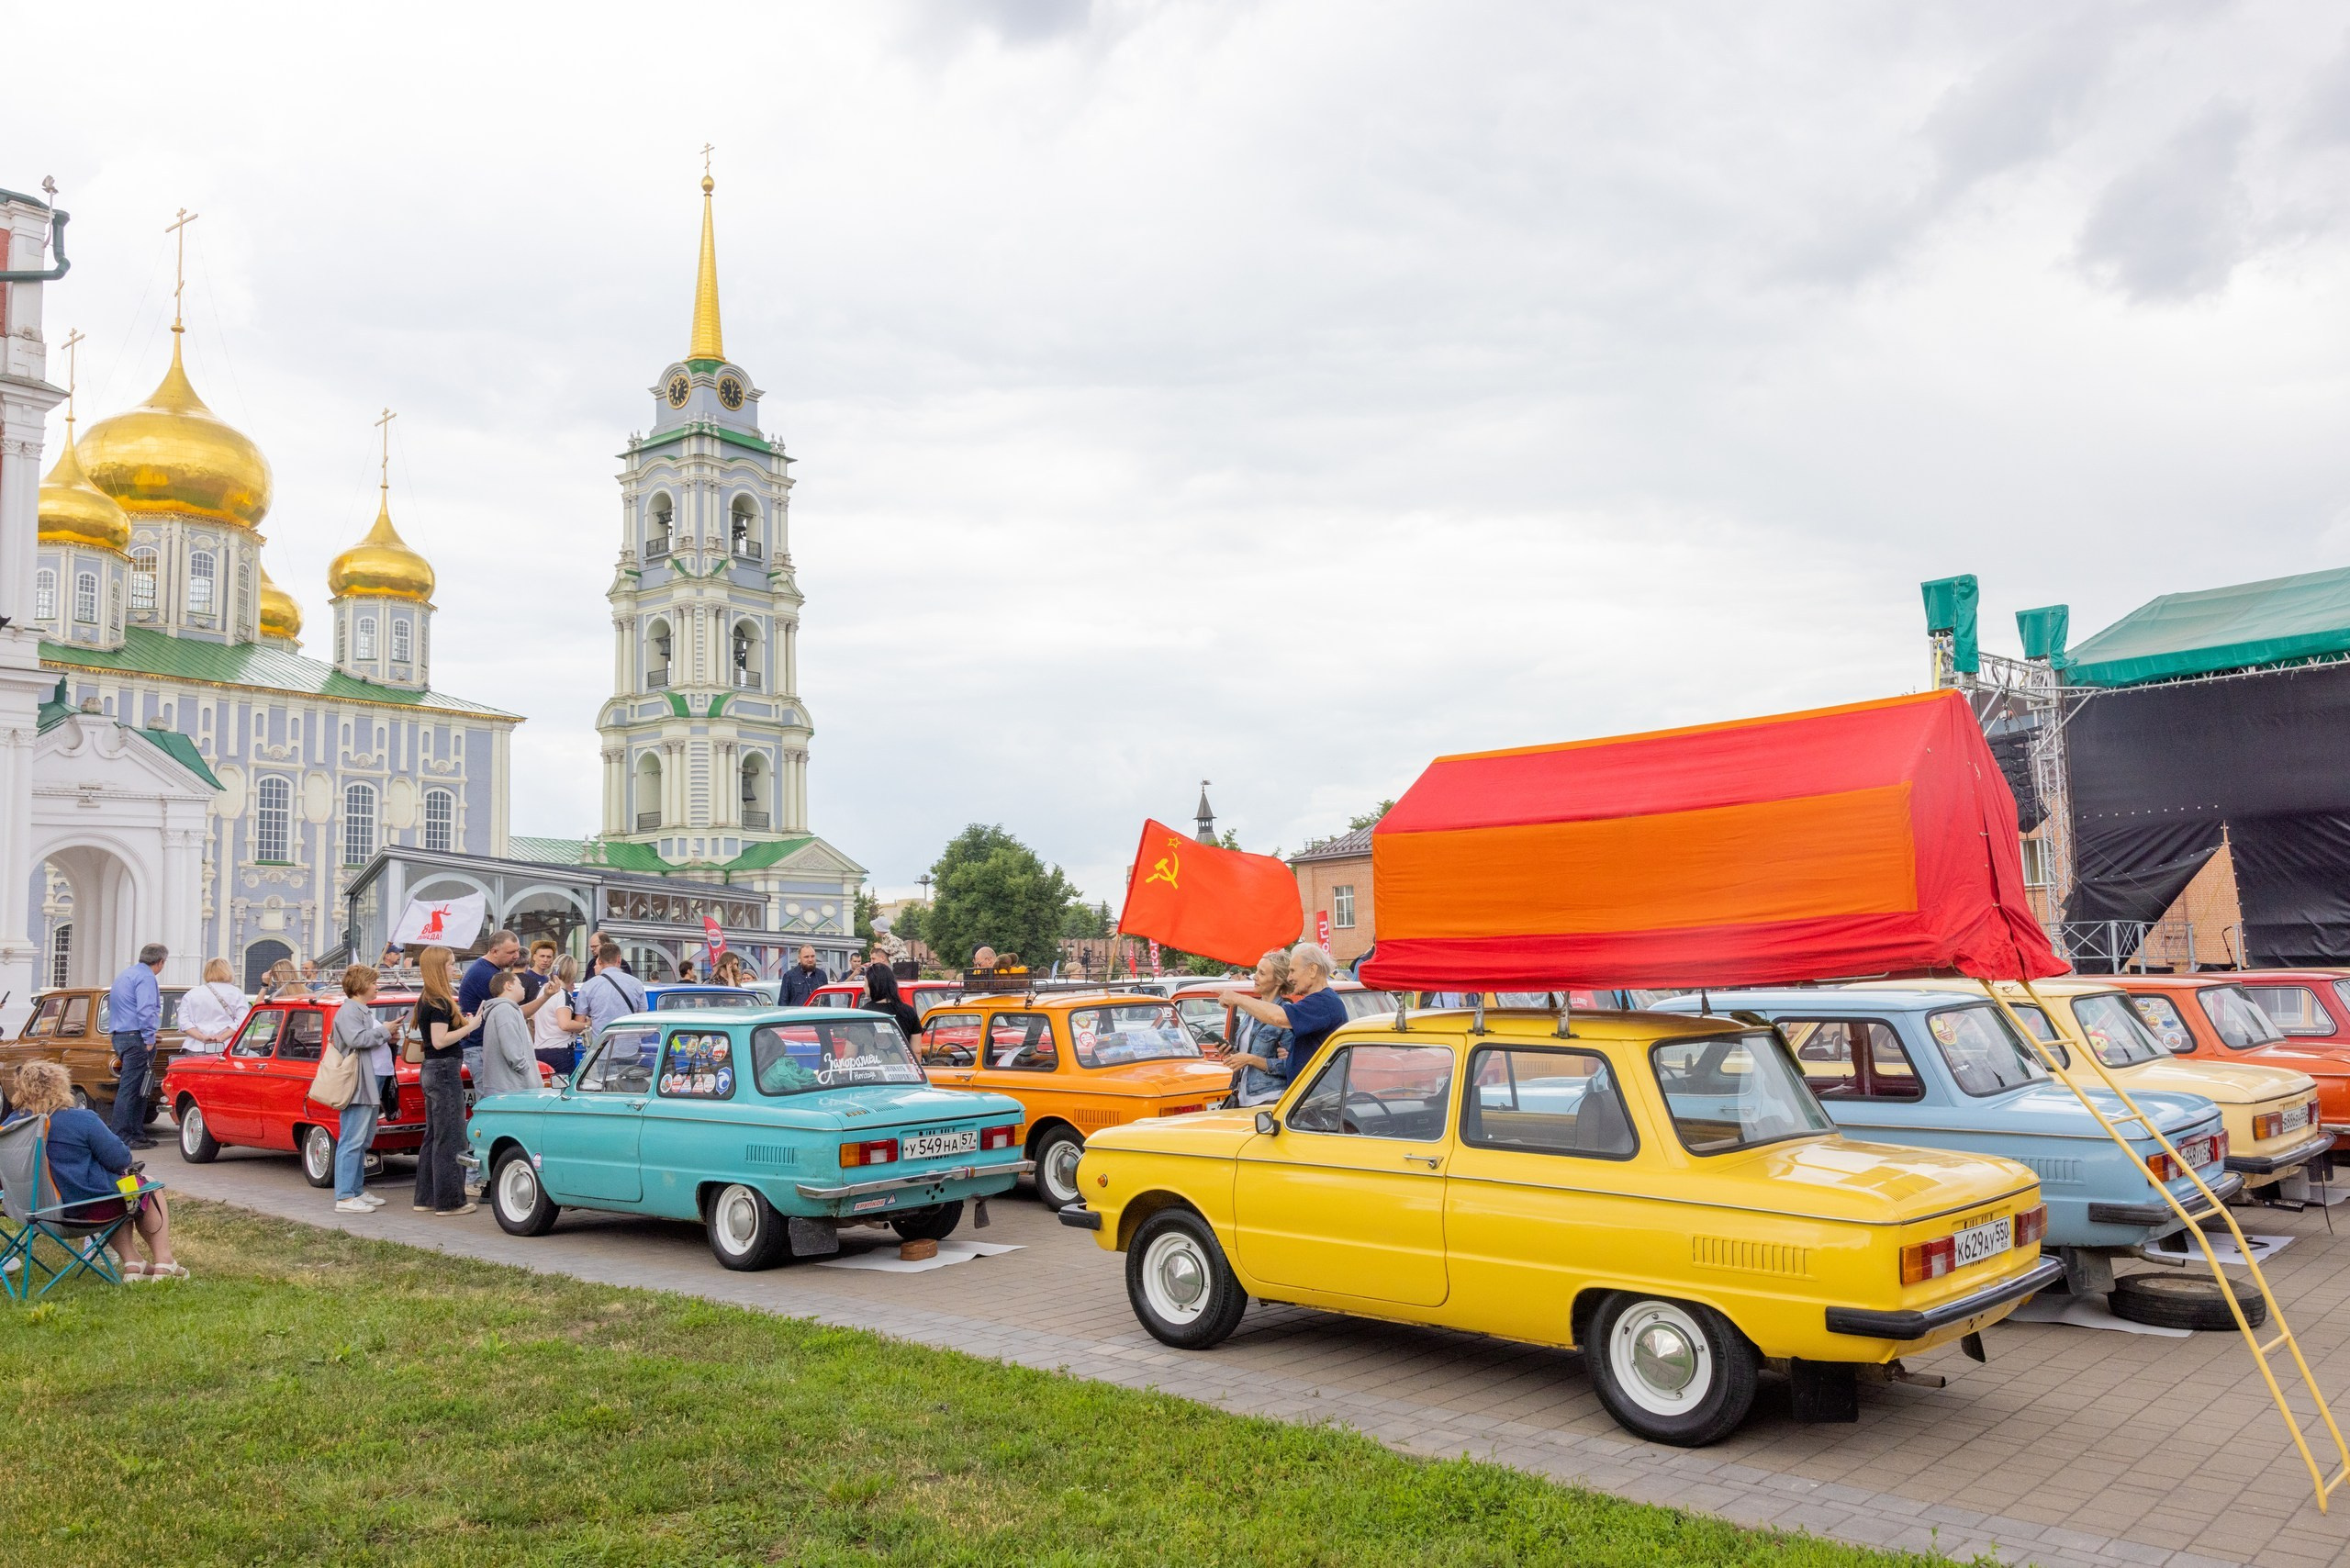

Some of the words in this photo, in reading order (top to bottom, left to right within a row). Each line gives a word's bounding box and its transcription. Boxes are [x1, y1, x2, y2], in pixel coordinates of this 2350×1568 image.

[962, 1133, 973, 1146] 57
[1957, 1230, 1995, 1262] К629АУ
[1995, 1221, 2009, 1243] 550
